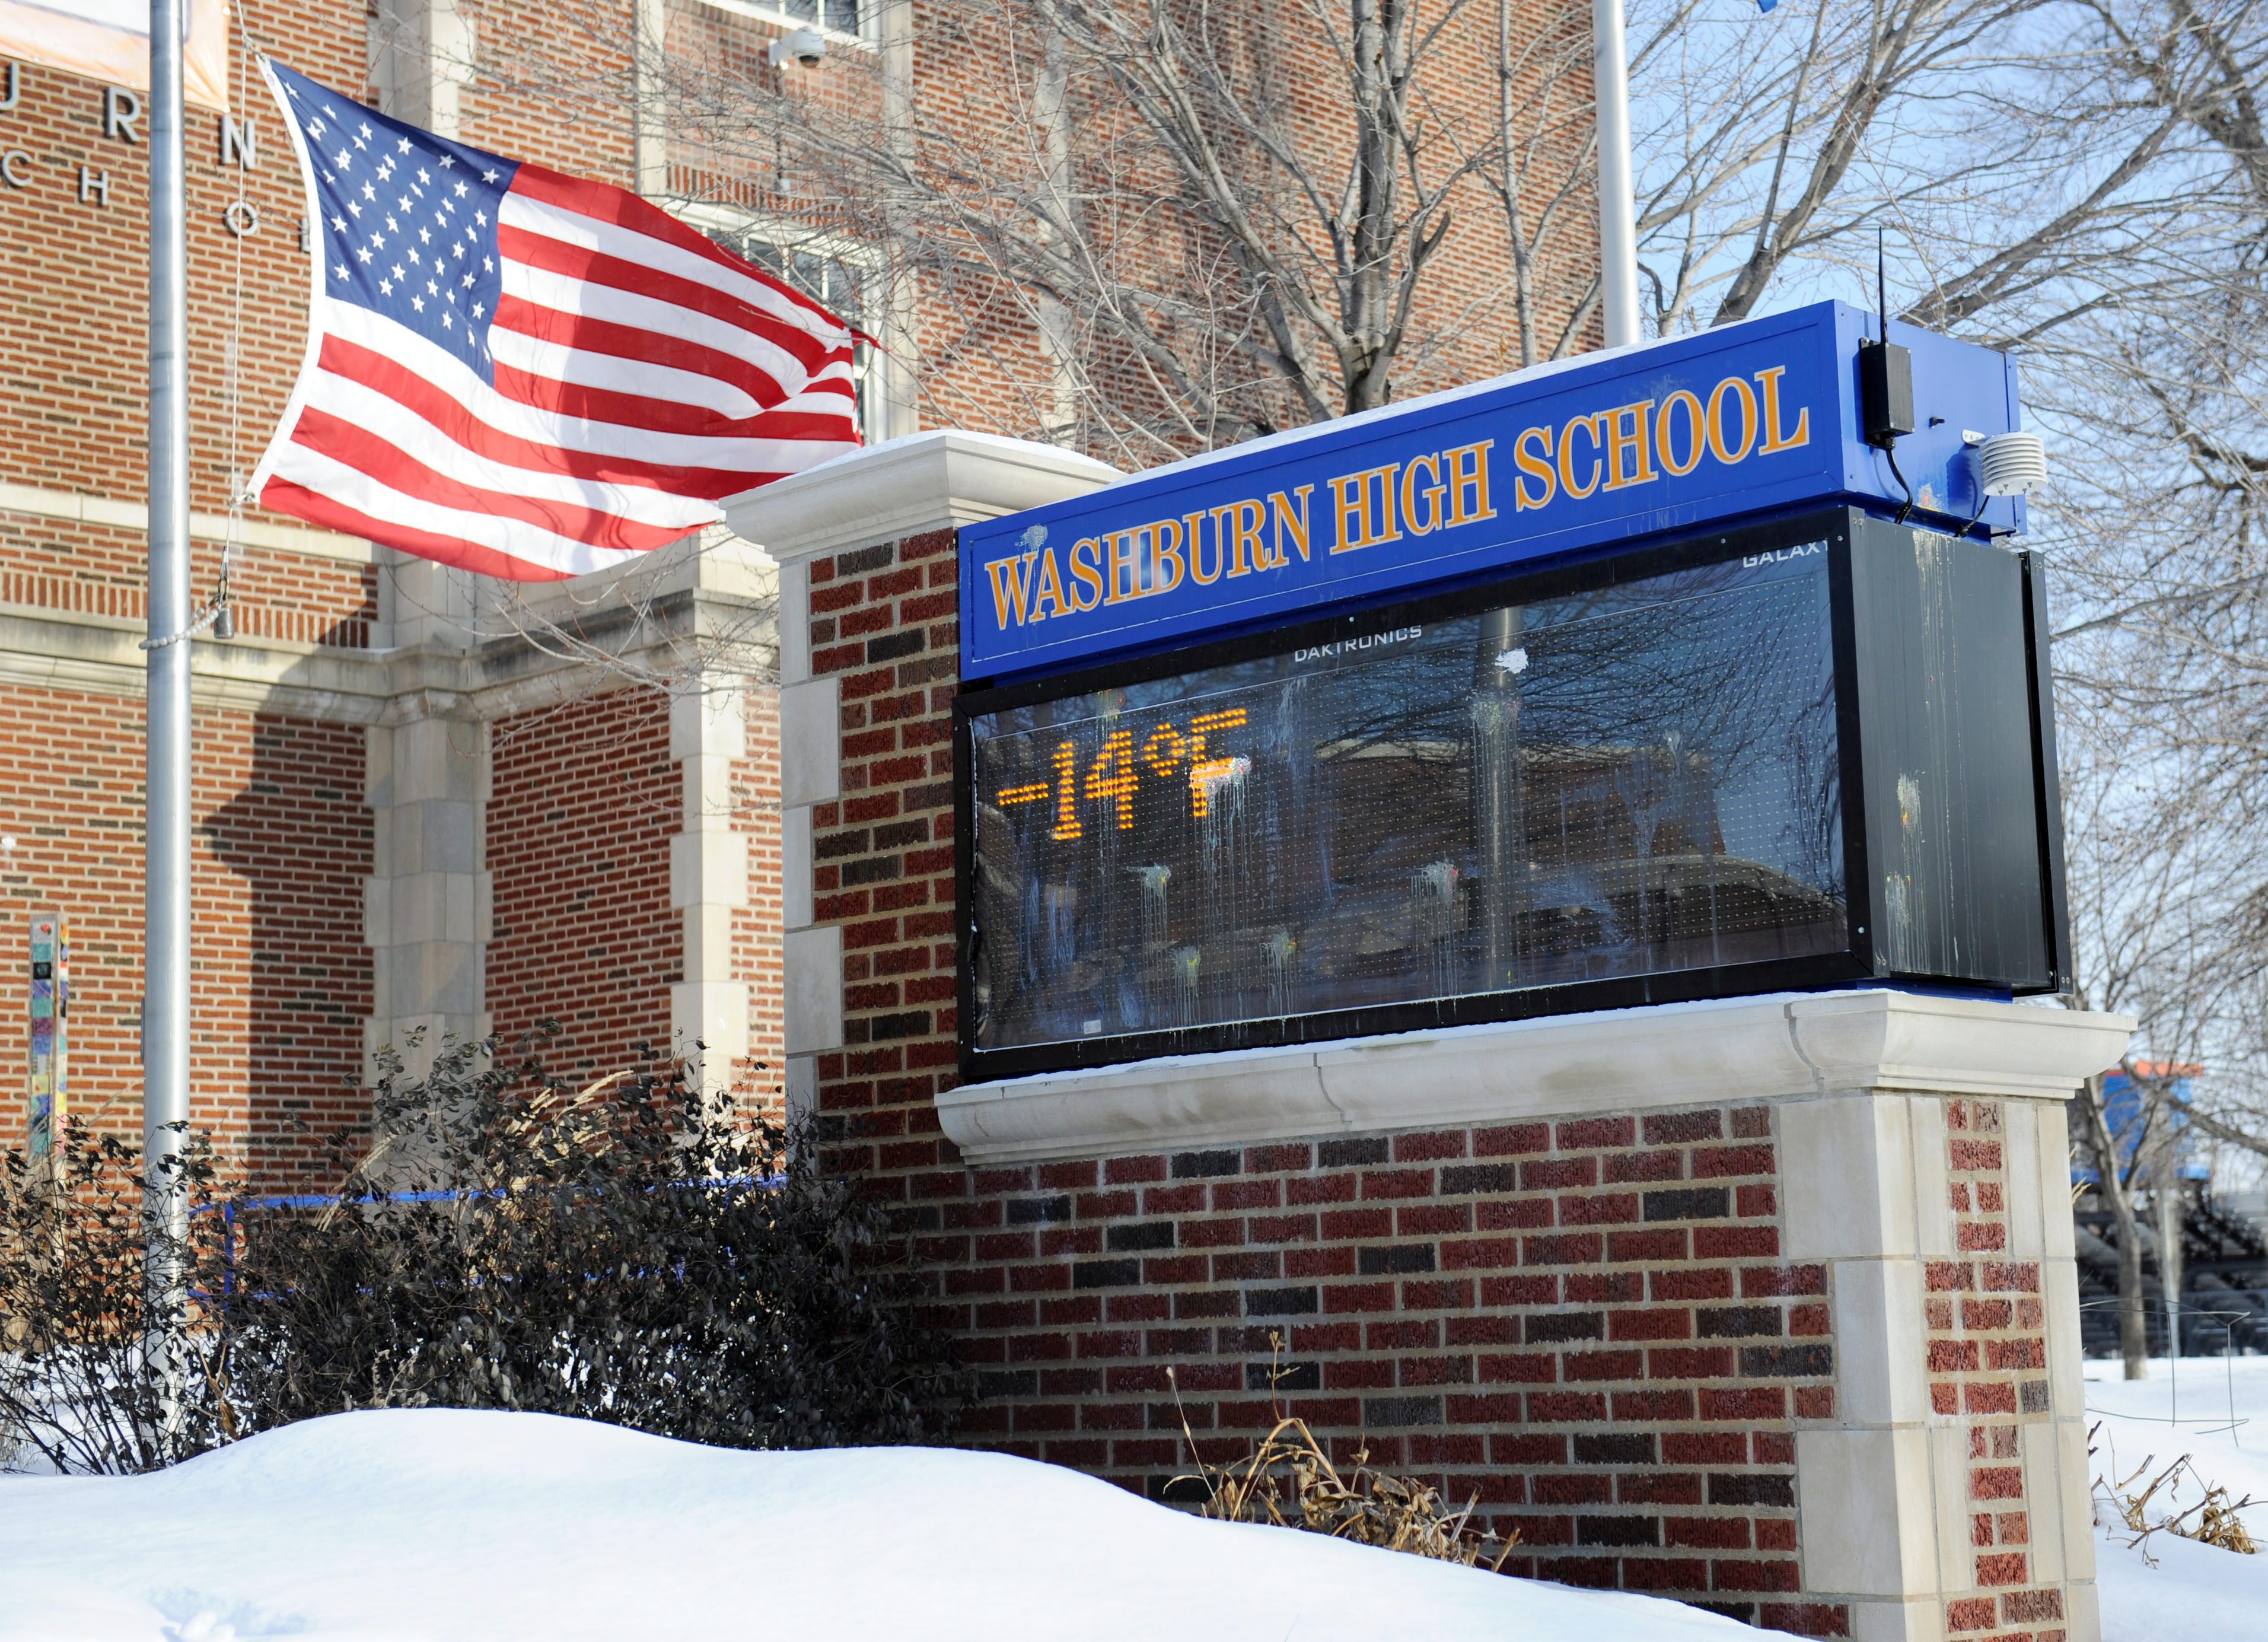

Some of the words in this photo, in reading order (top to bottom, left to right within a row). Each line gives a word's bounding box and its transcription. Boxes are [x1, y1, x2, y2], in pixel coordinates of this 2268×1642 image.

[984, 485, 1314, 631] WASHBURN
[1329, 438, 1497, 555] HIGH
[1514, 365, 1810, 513] SCHOOL
